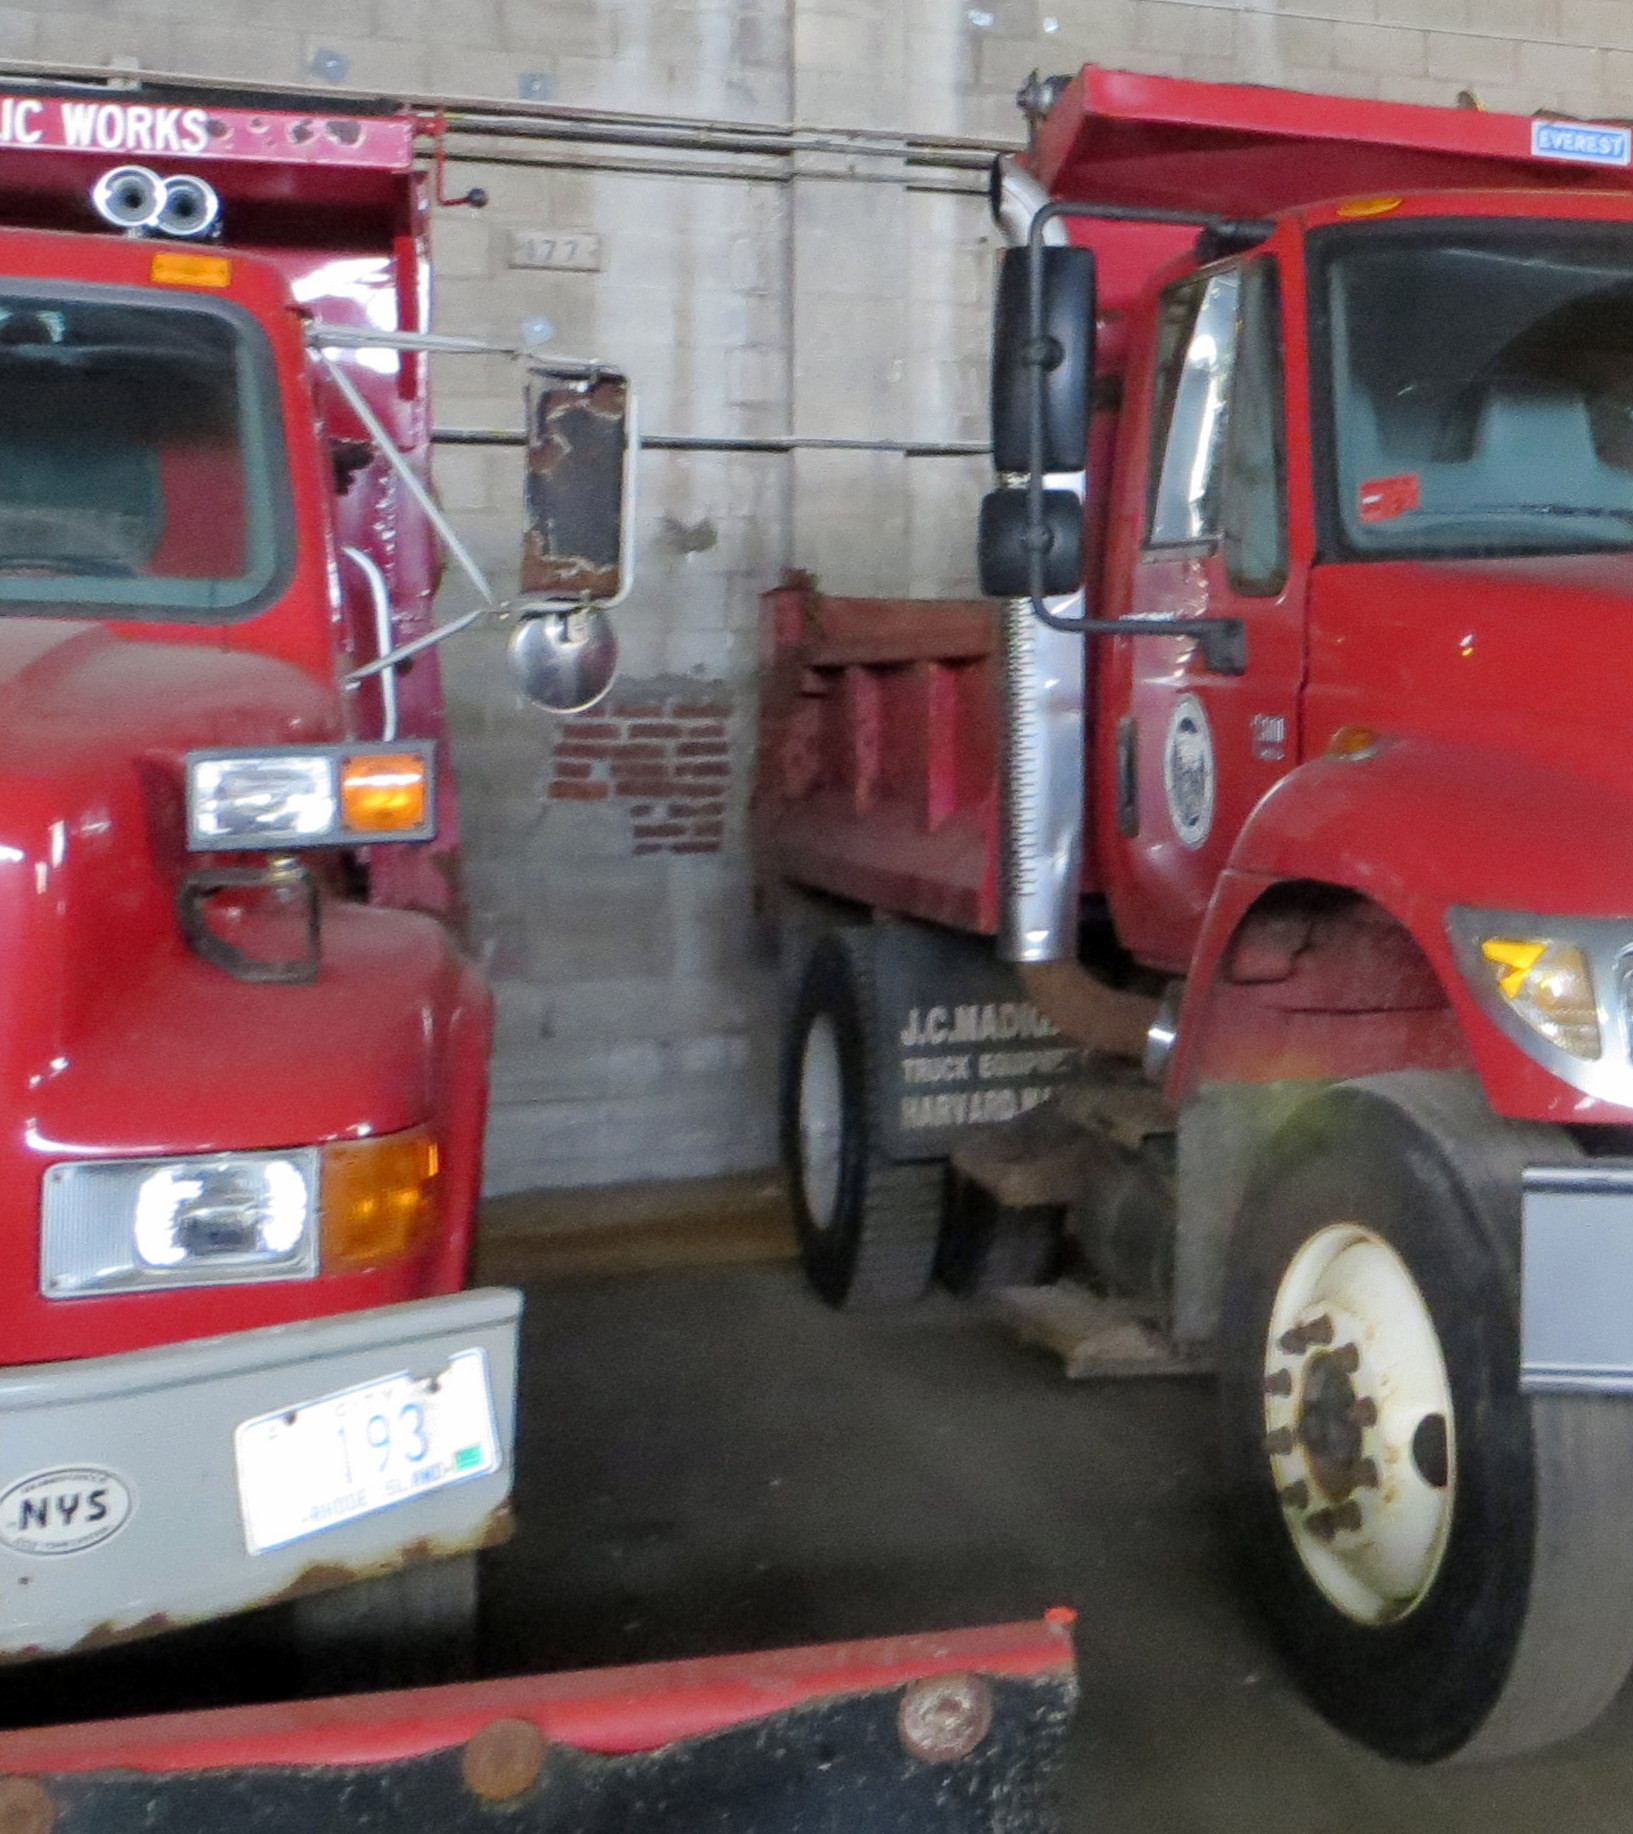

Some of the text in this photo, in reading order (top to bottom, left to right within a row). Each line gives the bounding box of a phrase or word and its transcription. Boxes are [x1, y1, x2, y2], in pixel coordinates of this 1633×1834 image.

[61, 103, 209, 152] WORKS
[1539, 129, 1624, 157] EVEREST
[336, 1402, 430, 1484] 193
[19, 1489, 107, 1531] NYS
